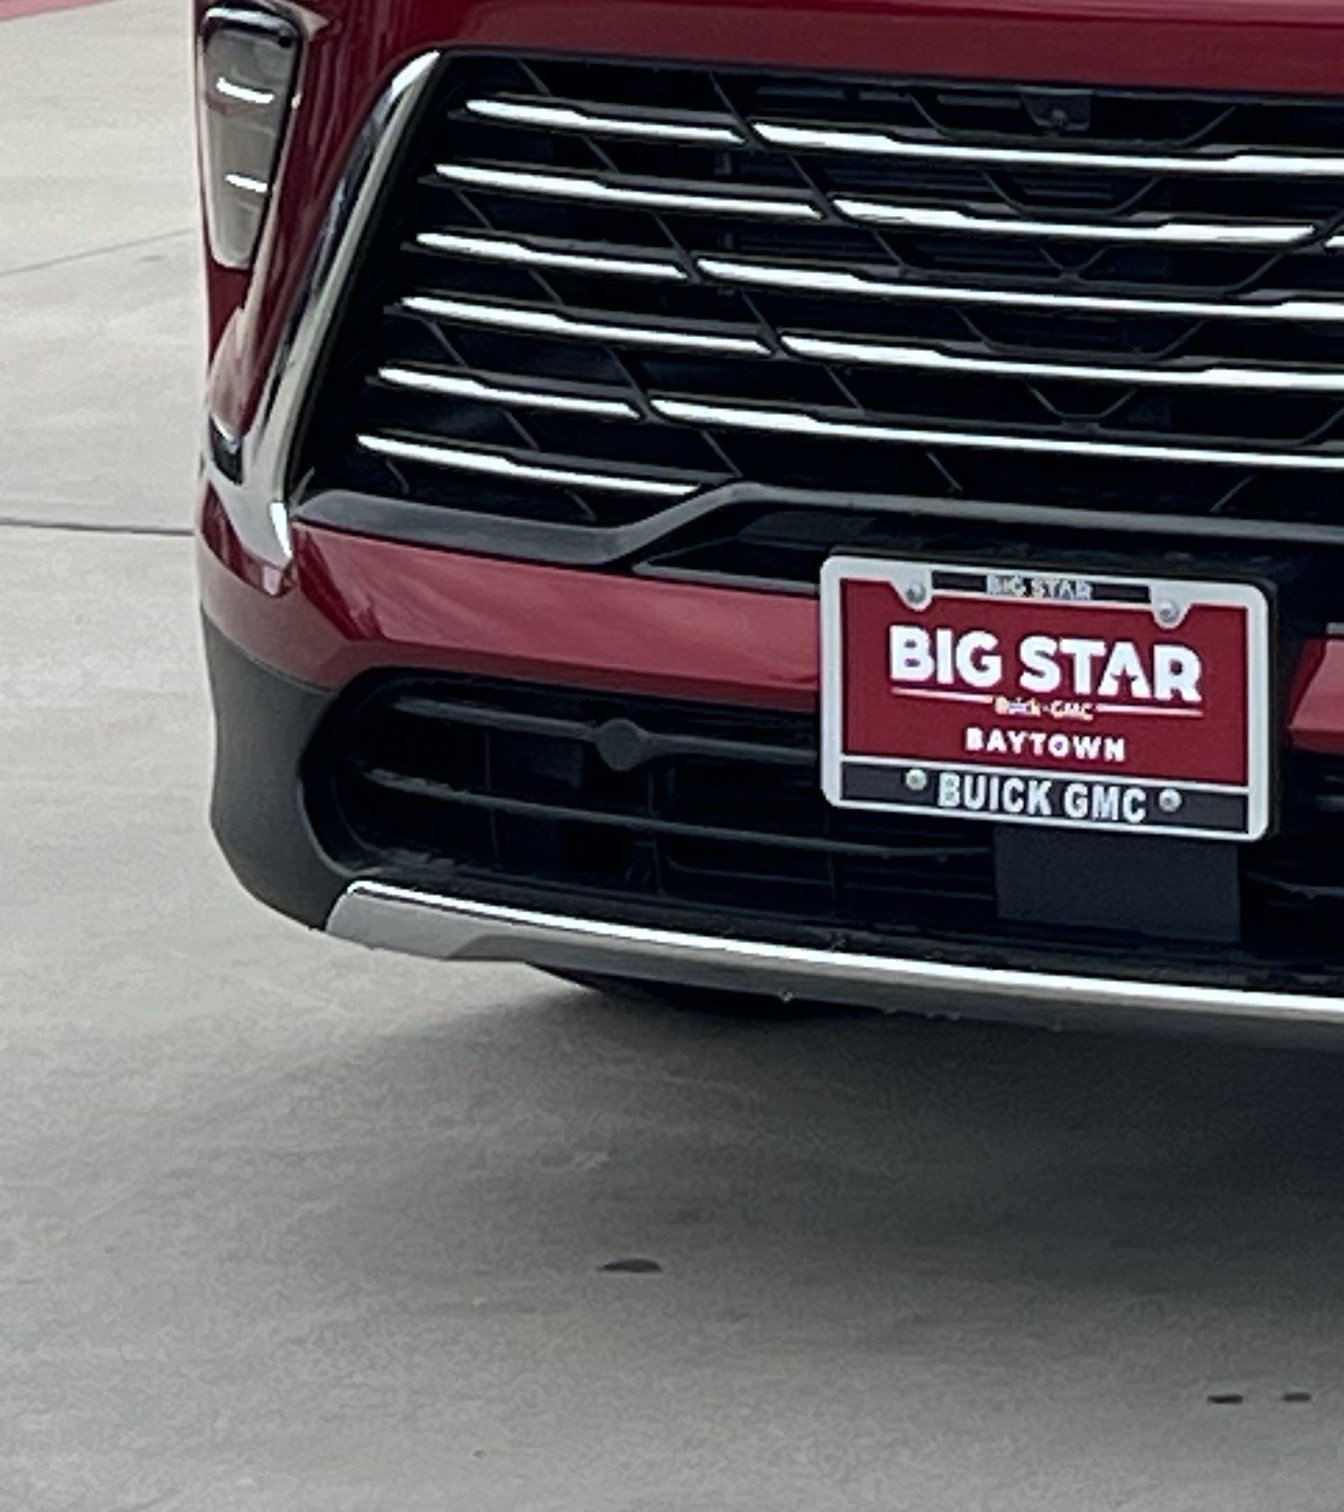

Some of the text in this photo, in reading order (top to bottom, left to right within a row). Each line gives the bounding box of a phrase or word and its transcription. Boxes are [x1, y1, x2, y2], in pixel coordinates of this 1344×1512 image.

[1030, 577, 1093, 601] STAR
[889, 624, 1202, 702] BIG STAR
[965, 726, 1127, 763] BAYTOWN
[937, 771, 1148, 824] BUICK GMC
